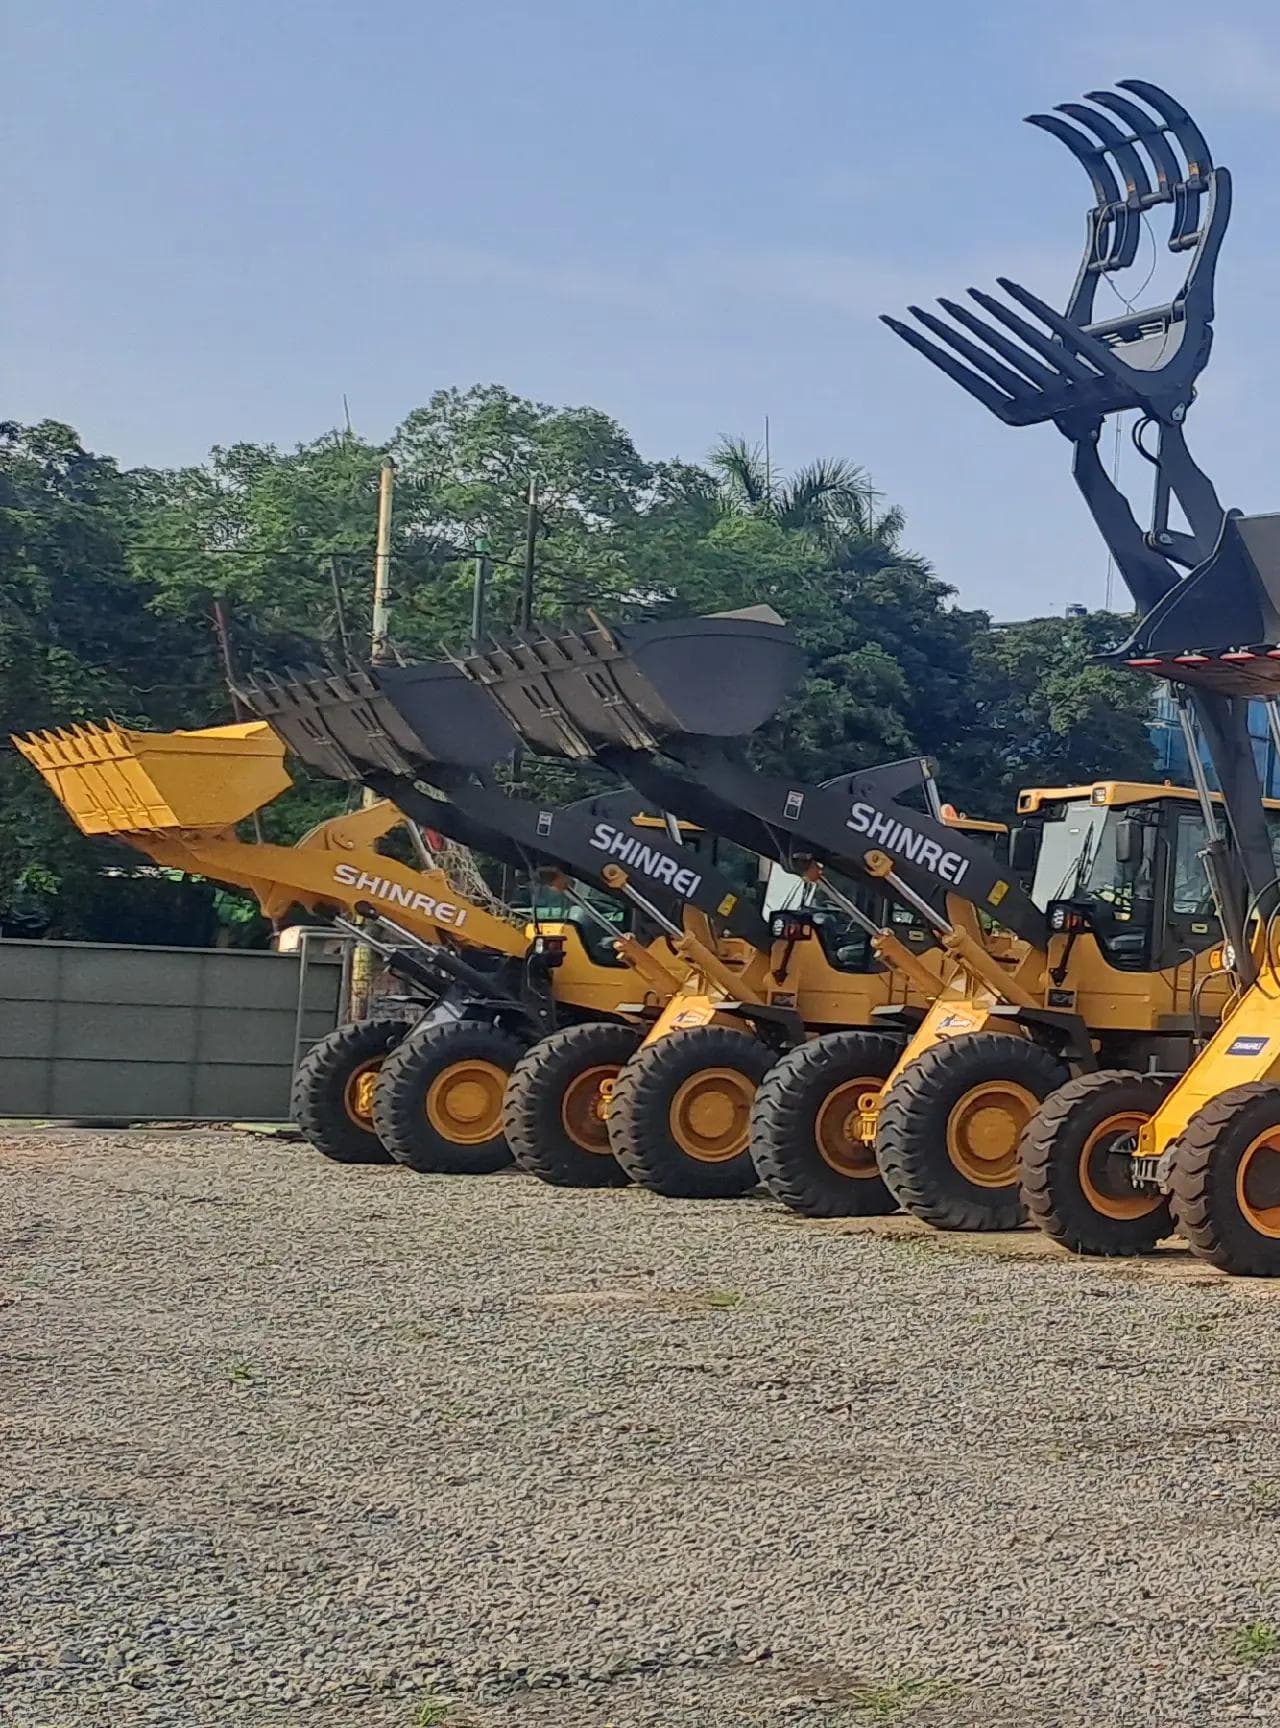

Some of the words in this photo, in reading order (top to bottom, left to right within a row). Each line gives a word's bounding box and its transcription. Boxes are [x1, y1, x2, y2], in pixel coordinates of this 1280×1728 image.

[589, 823, 702, 898] SHINREI
[846, 802, 969, 885] SHINREI
[333, 864, 467, 926] SHINREI
